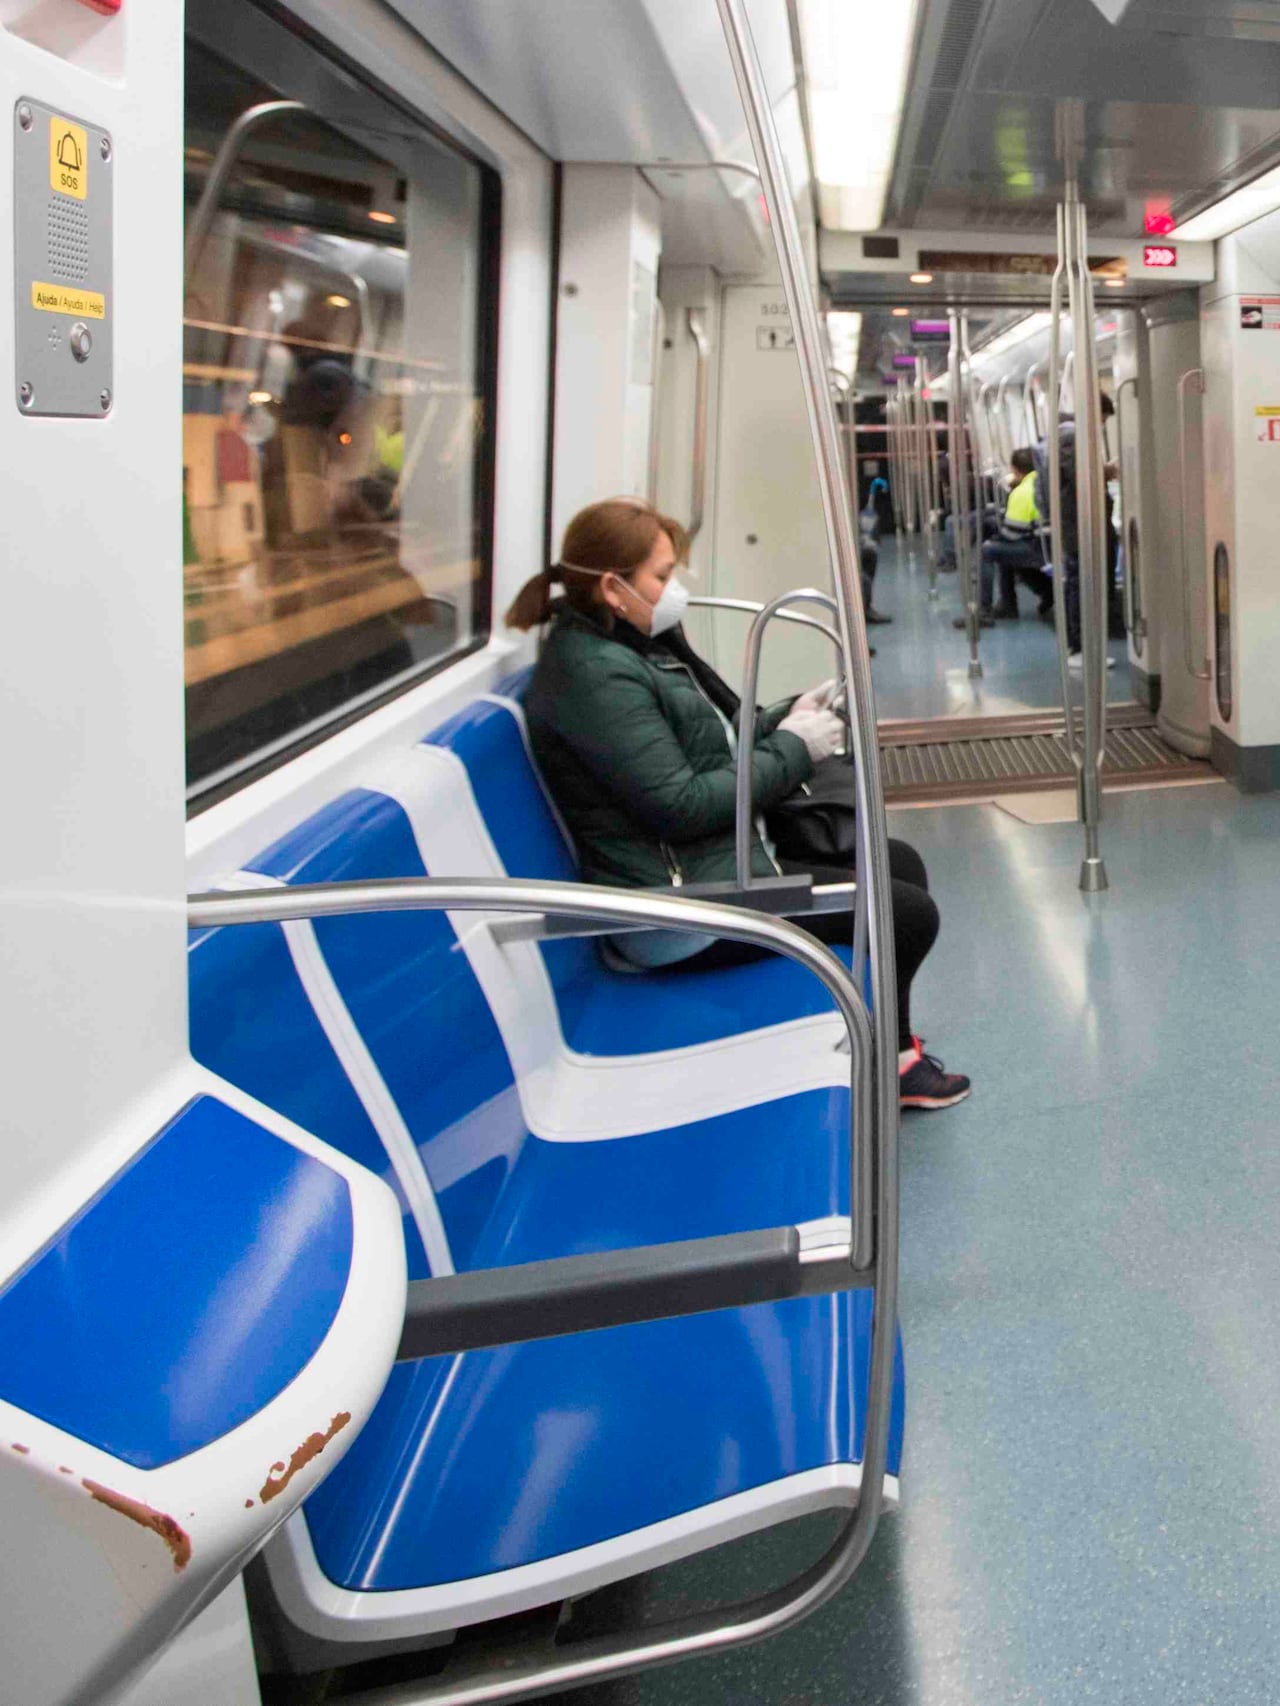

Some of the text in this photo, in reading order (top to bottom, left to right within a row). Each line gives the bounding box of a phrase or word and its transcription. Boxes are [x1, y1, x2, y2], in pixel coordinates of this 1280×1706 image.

[61, 173, 79, 190] SOS
[36, 292, 58, 307] Ajuda
[63, 296, 83, 311] Ayuda
